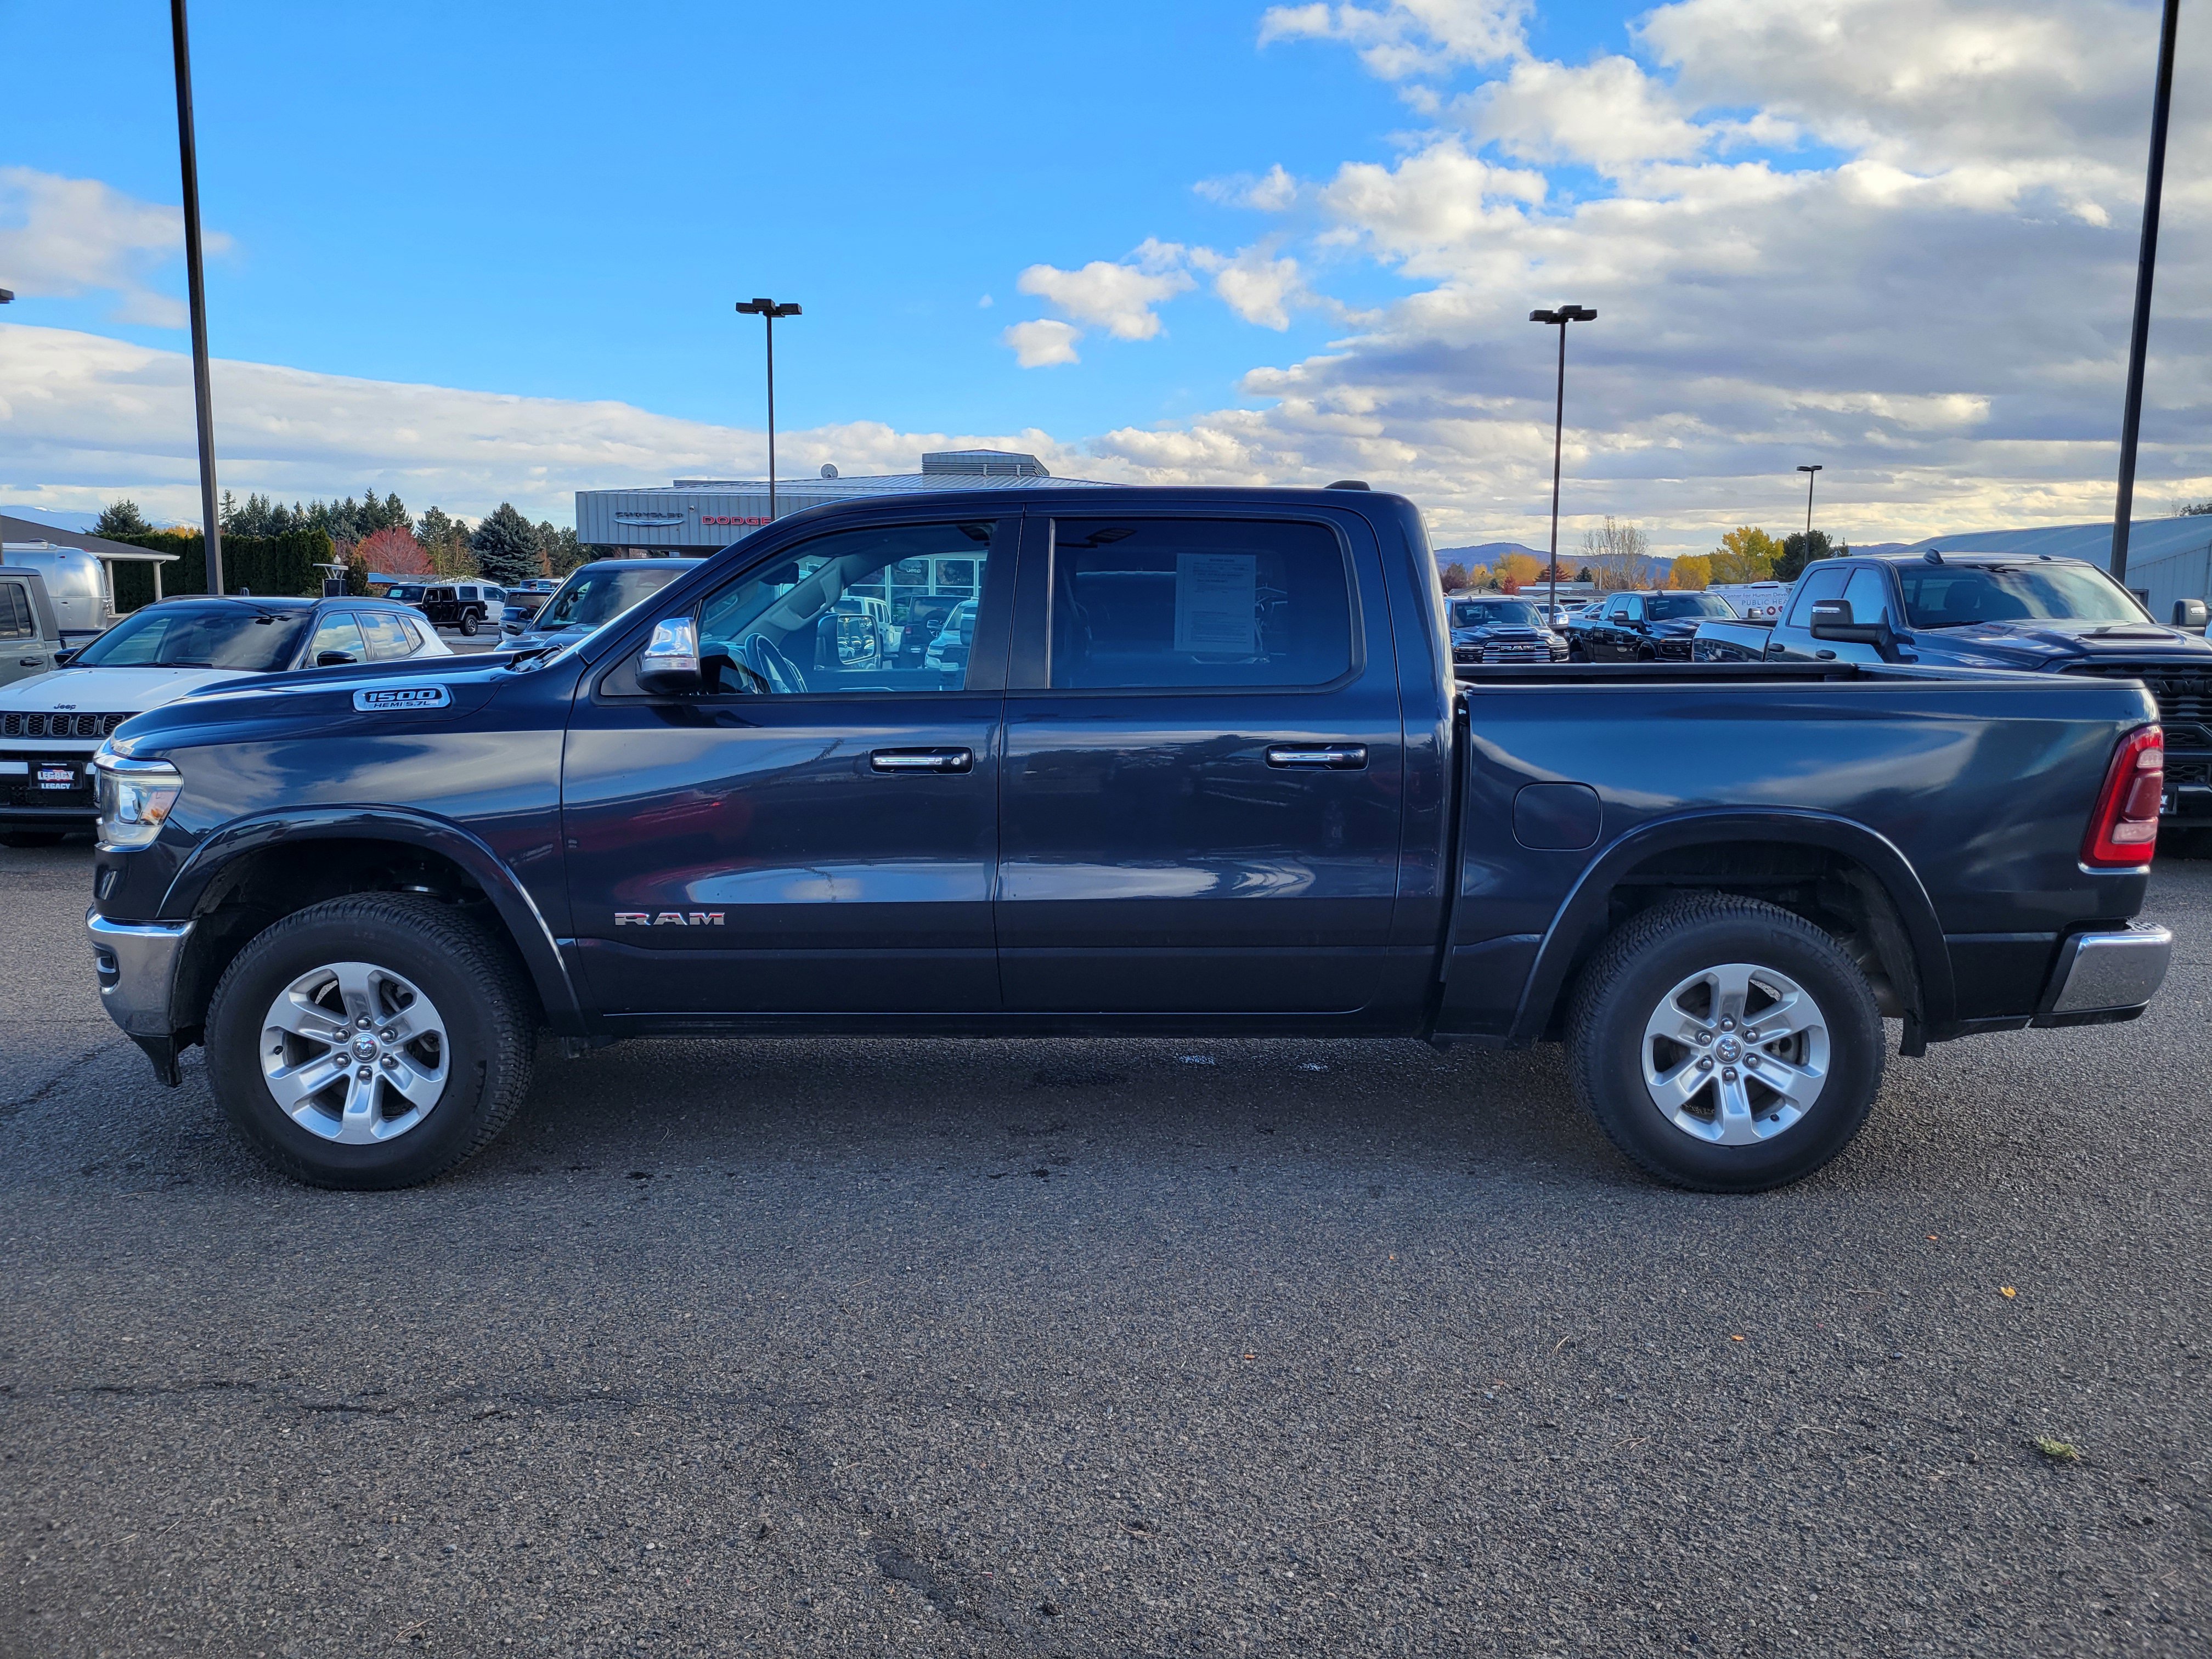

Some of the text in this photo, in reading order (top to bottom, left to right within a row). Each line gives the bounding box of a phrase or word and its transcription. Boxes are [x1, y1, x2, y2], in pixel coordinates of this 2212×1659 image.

[702, 516, 771, 525] DODGE
[369, 690, 436, 702] 1500
[37, 771, 75, 781] LEGACY
[614, 912, 725, 926] RAM
